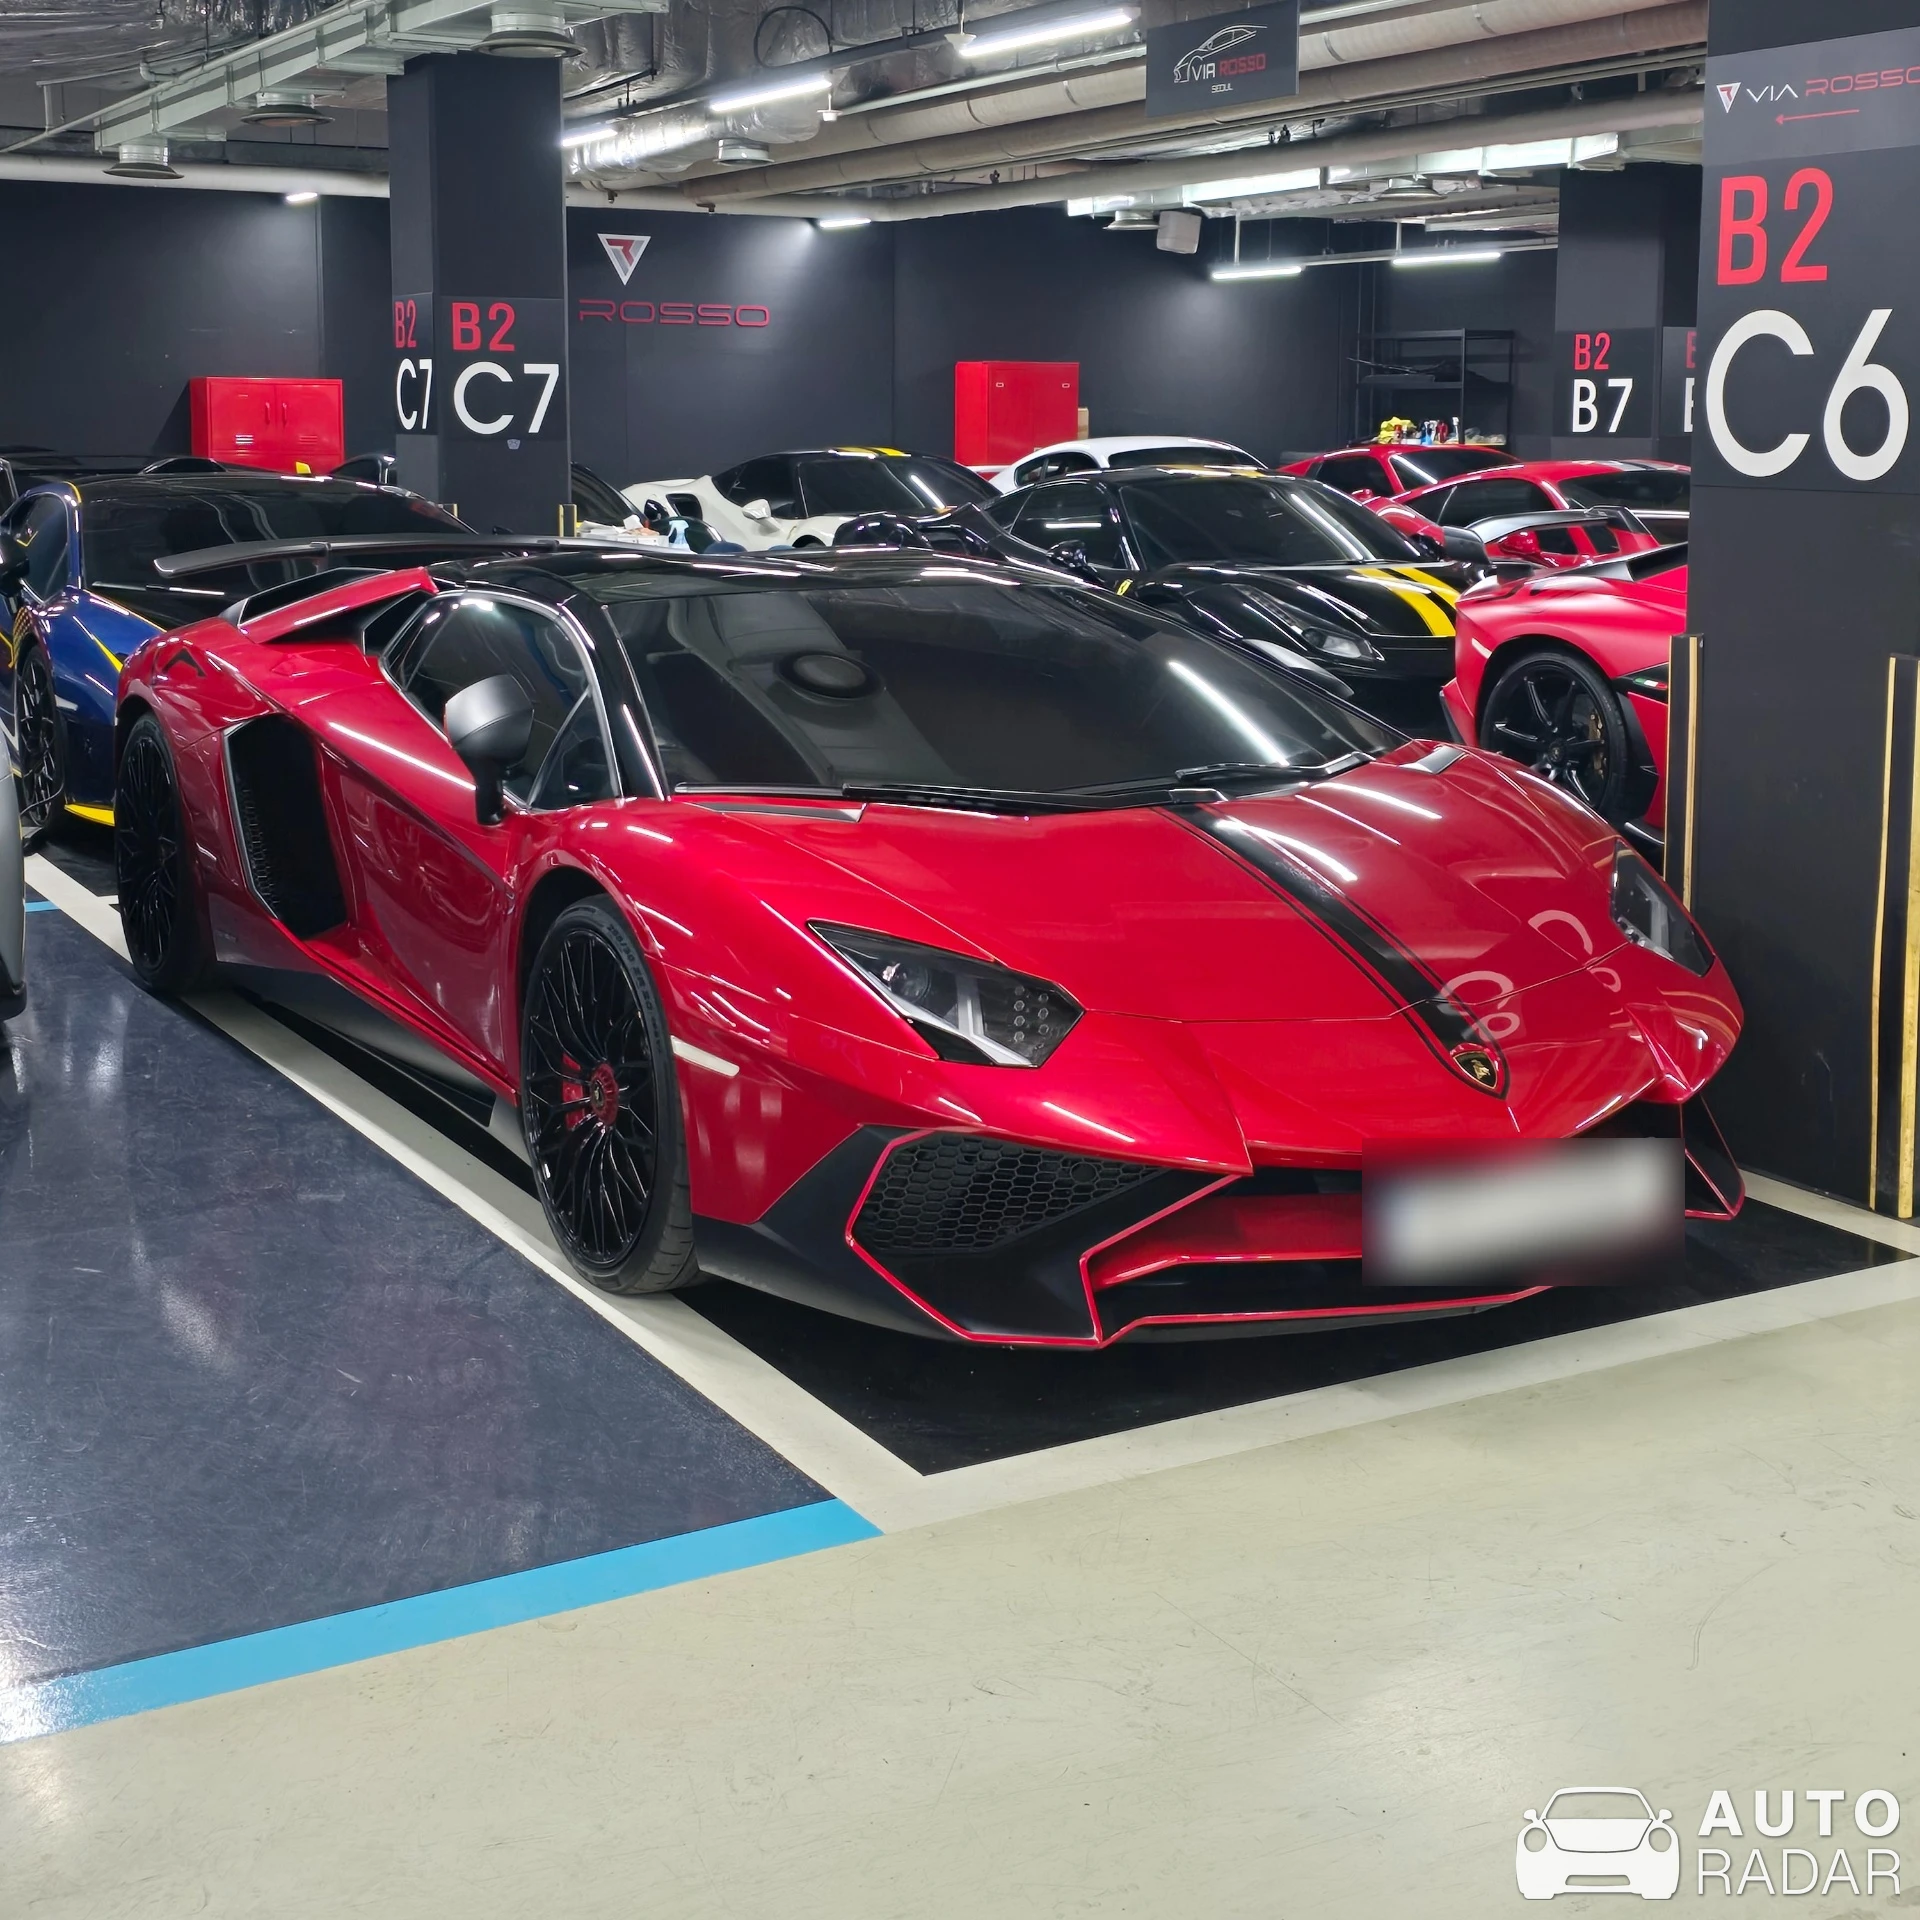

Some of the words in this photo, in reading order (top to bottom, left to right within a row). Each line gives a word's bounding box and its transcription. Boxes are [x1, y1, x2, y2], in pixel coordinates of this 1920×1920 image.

[1192, 62, 1216, 81] VIA
[1219, 53, 1266, 76] ROSSO
[1211, 83, 1234, 94] SEOUL
[1746, 83, 1799, 102] VIA
[1717, 167, 1834, 286] B2
[394, 299, 417, 348] B2
[451, 302, 515, 351] B2
[578, 299, 770, 327] ROSSO
[1574, 332, 1612, 370] B2
[396, 358, 432, 430] C7
[454, 361, 560, 435] C7
[1572, 378, 1633, 433] B7
[1706, 308, 1909, 481] C6
